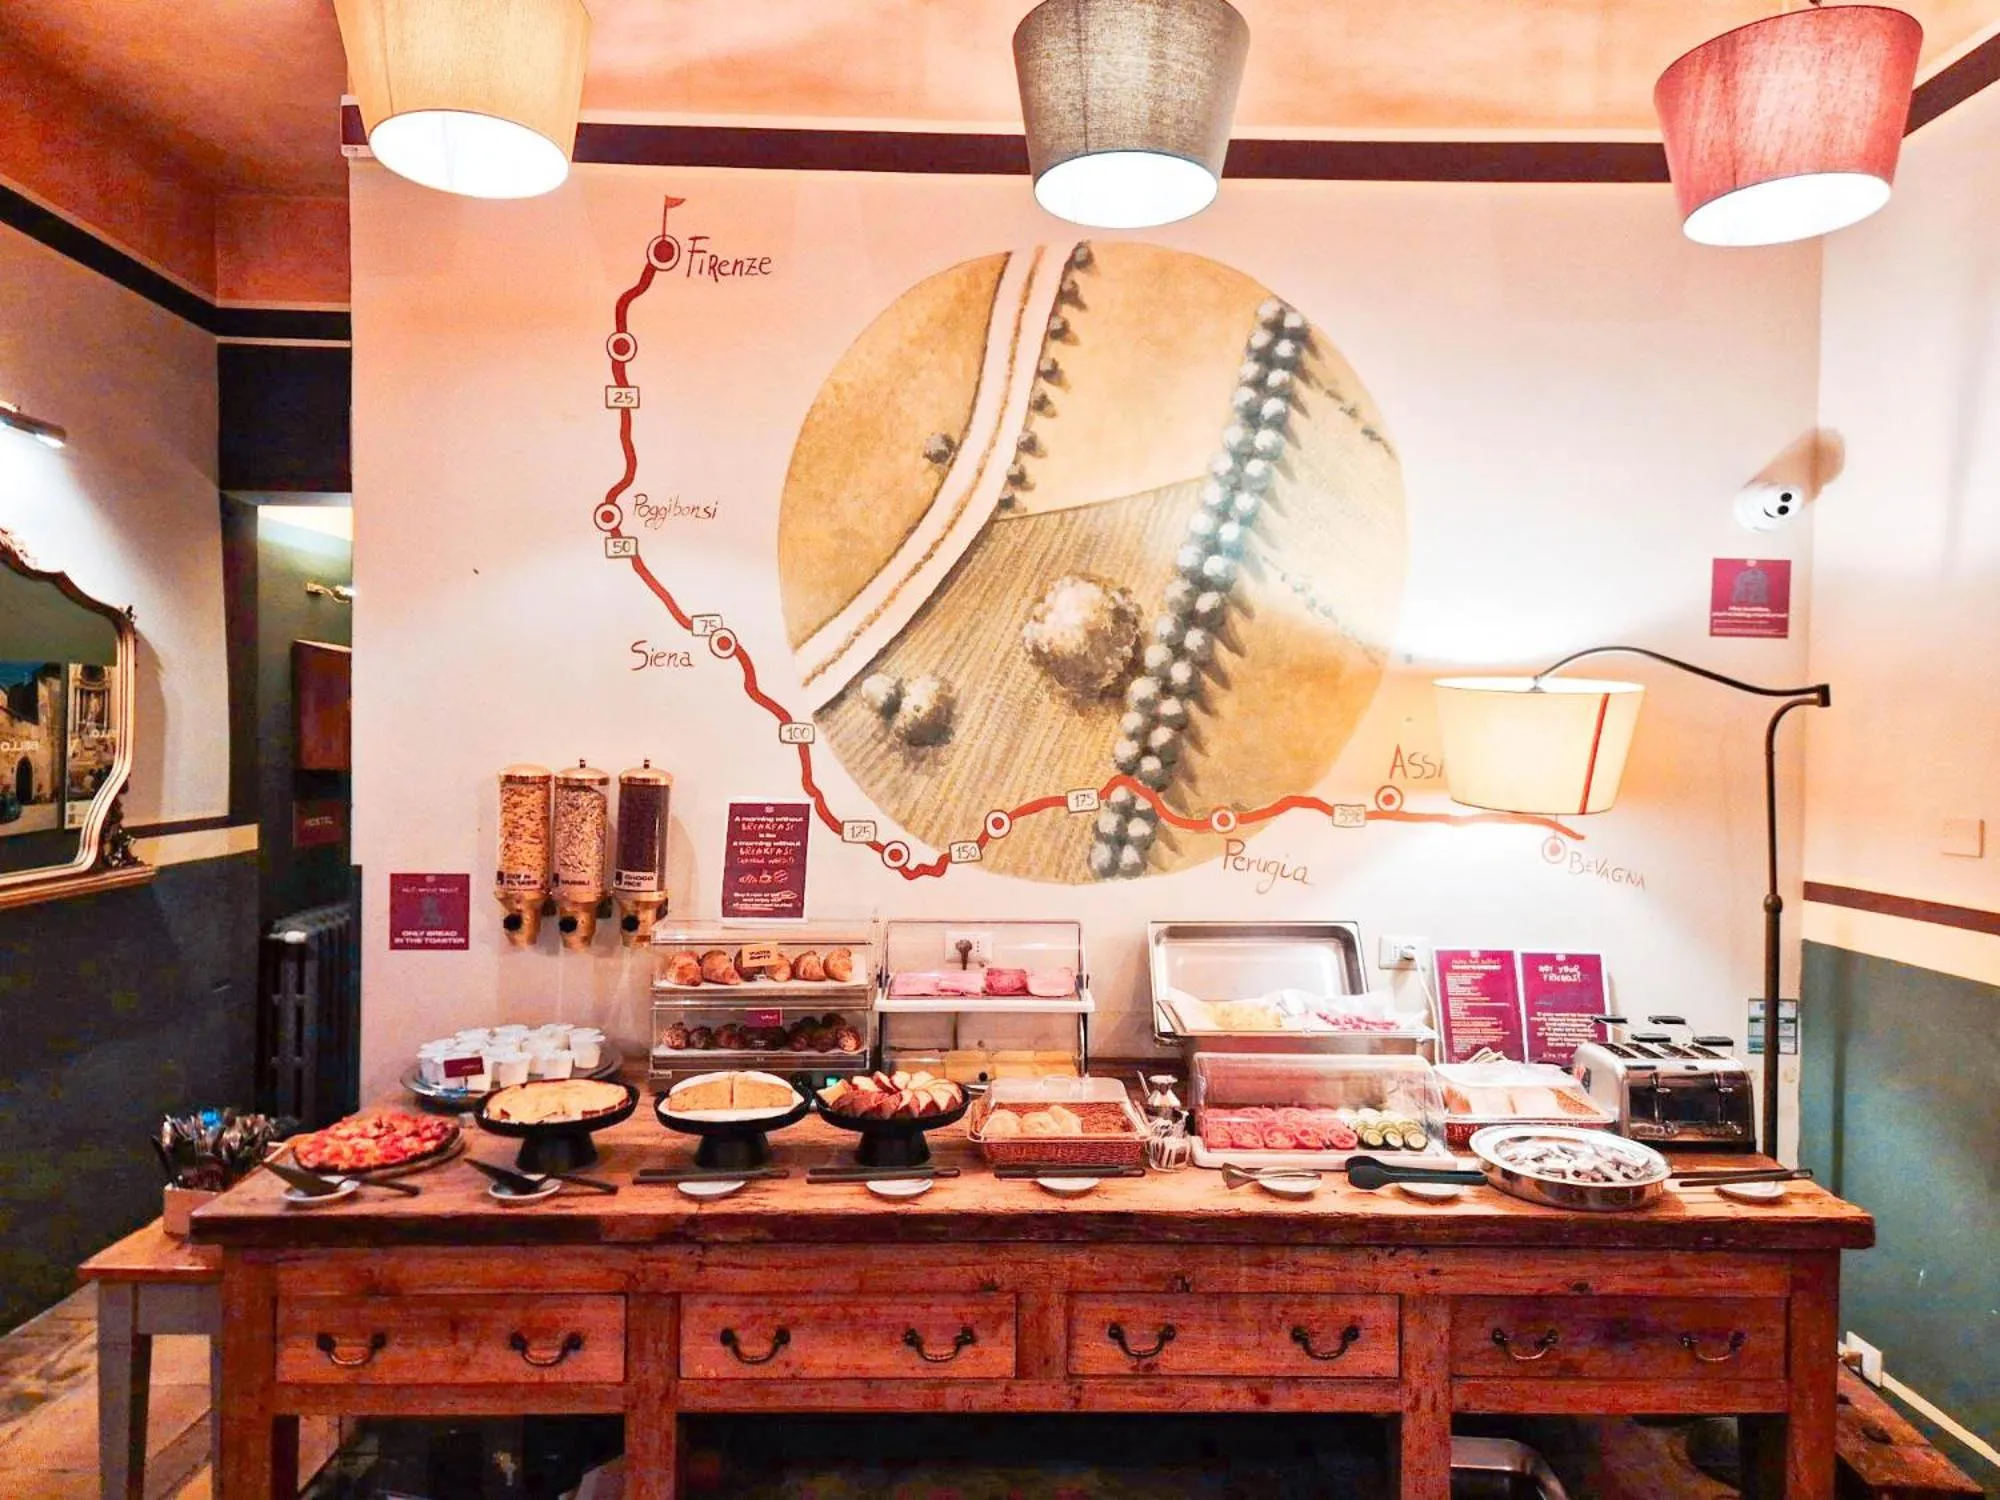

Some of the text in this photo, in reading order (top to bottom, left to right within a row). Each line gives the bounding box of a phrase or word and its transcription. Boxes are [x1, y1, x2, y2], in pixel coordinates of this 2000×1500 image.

[613, 391, 635, 404] 25
[612, 540, 632, 554] 50
[700, 619, 719, 633] 75
[630, 639, 695, 671] Siena
[785, 726, 812, 741] 100
[1388, 743, 1444, 780] ASSI
[1073, 793, 1095, 808] 175
[849, 822, 872, 839] 125
[955, 843, 978, 859] 150
[1223, 838, 1313, 895] Perugia
